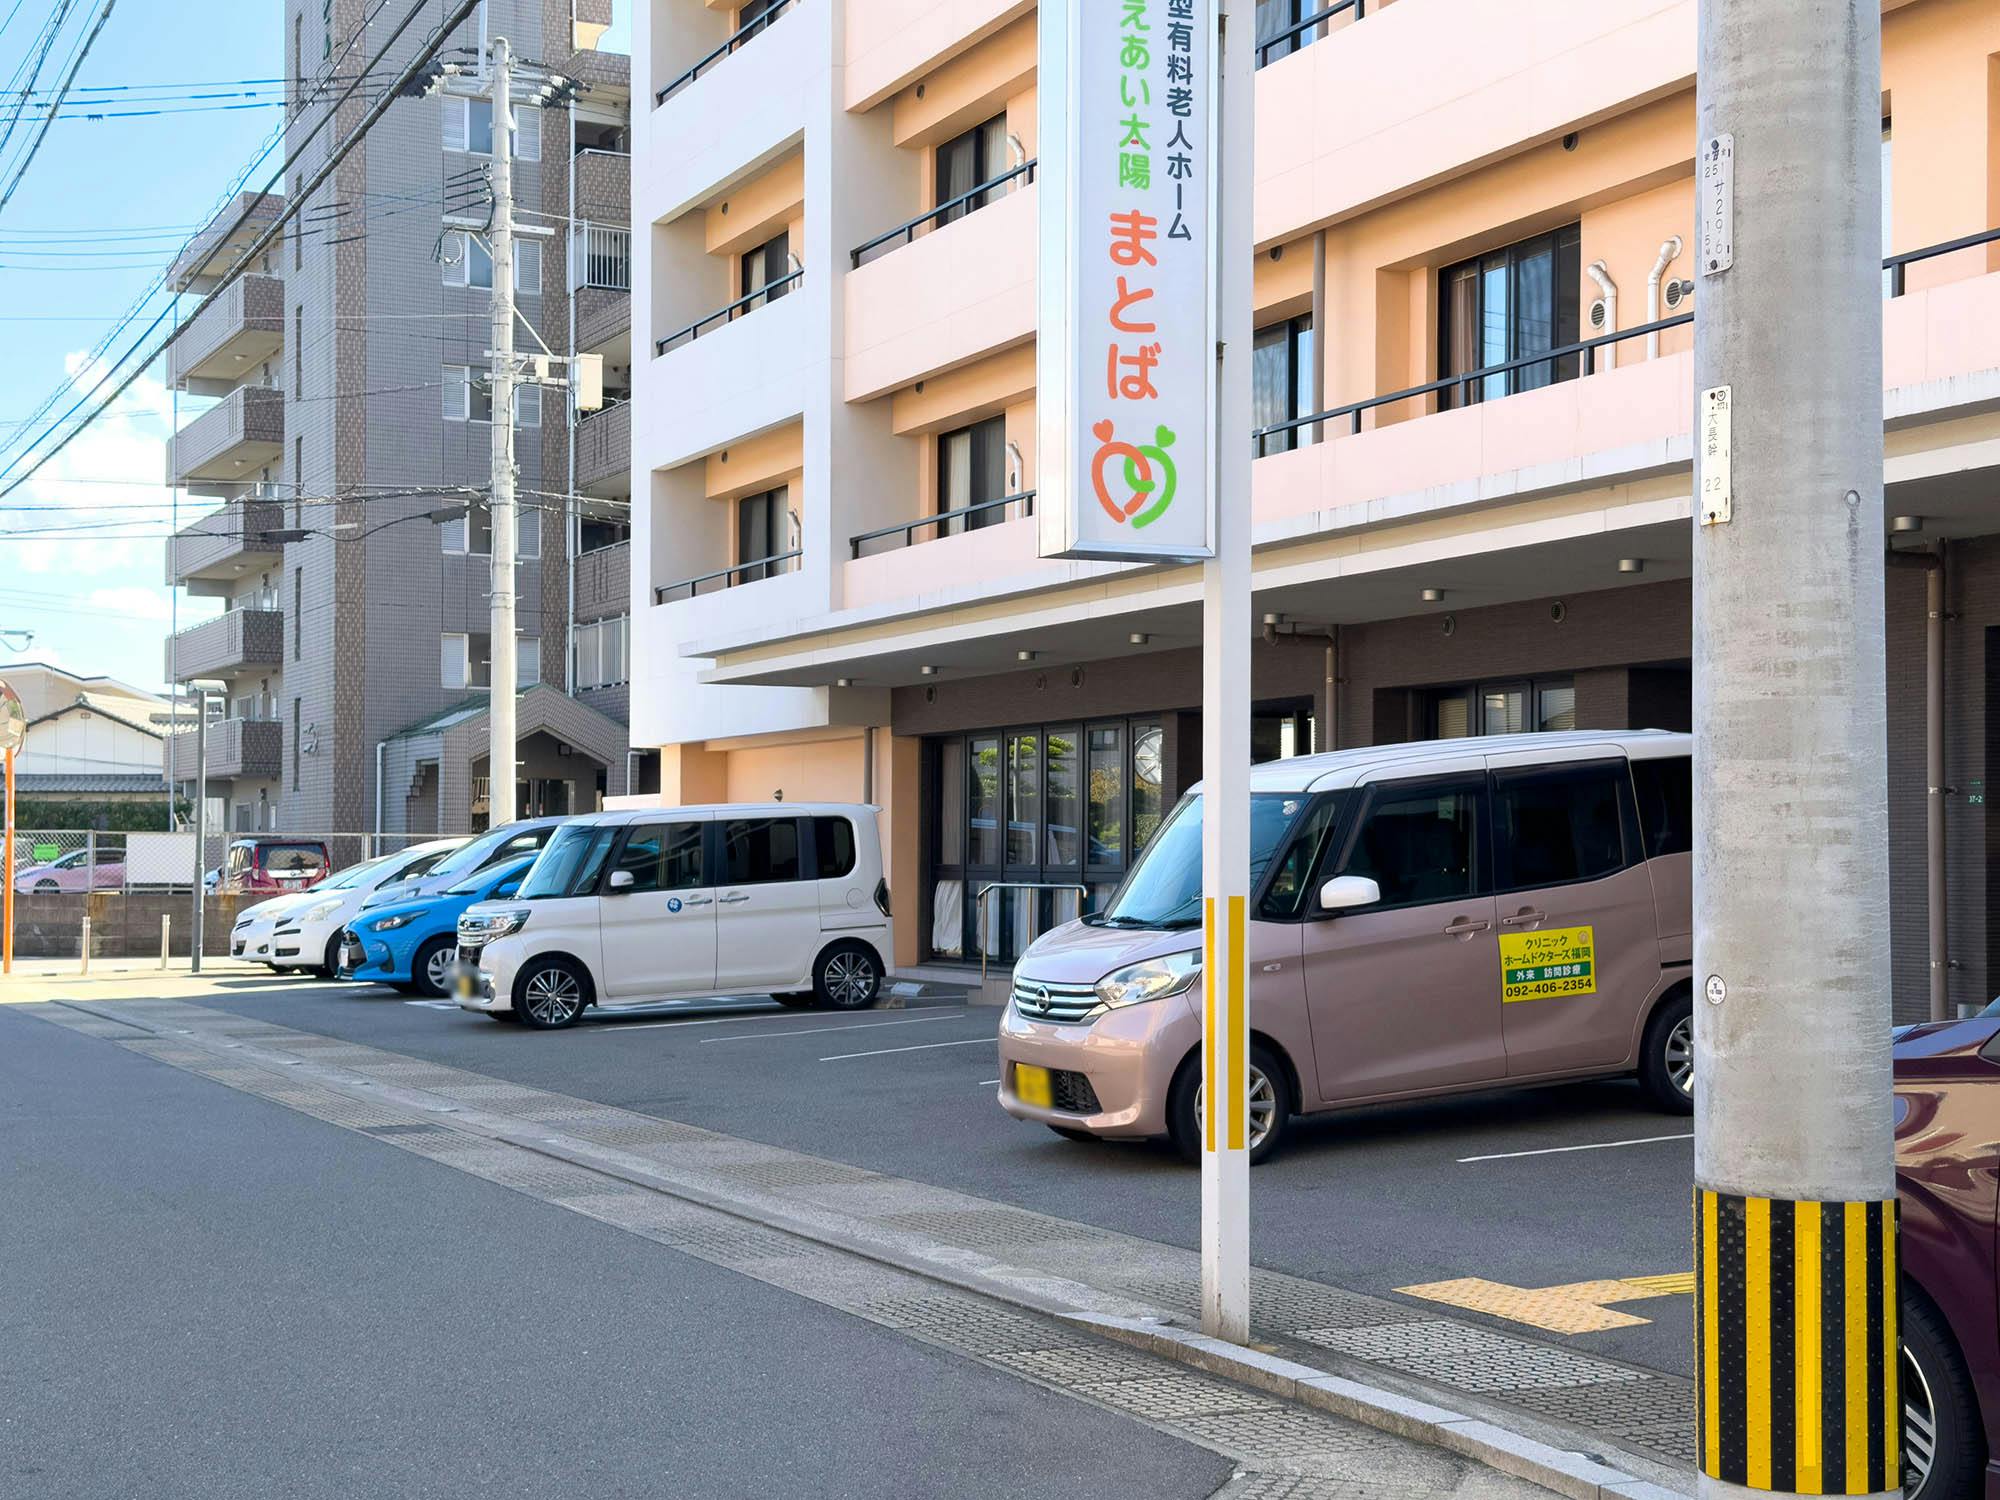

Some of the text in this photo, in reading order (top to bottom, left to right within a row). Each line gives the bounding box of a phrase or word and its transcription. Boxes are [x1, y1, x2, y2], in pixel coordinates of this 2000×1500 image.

[1167, 0, 1194, 241] 型有料老人ホーム
[1108, 0, 1161, 400] えあい太陽 まとば
[1705, 476, 1721, 492] 22
[1525, 936, 1568, 949] クリニック
[1504, 946, 1591, 966] ホームドクターズ福岡
[1516, 964, 1581, 981] 外来 訪問診療
[1506, 979, 1592, 997] 092-406-2354
